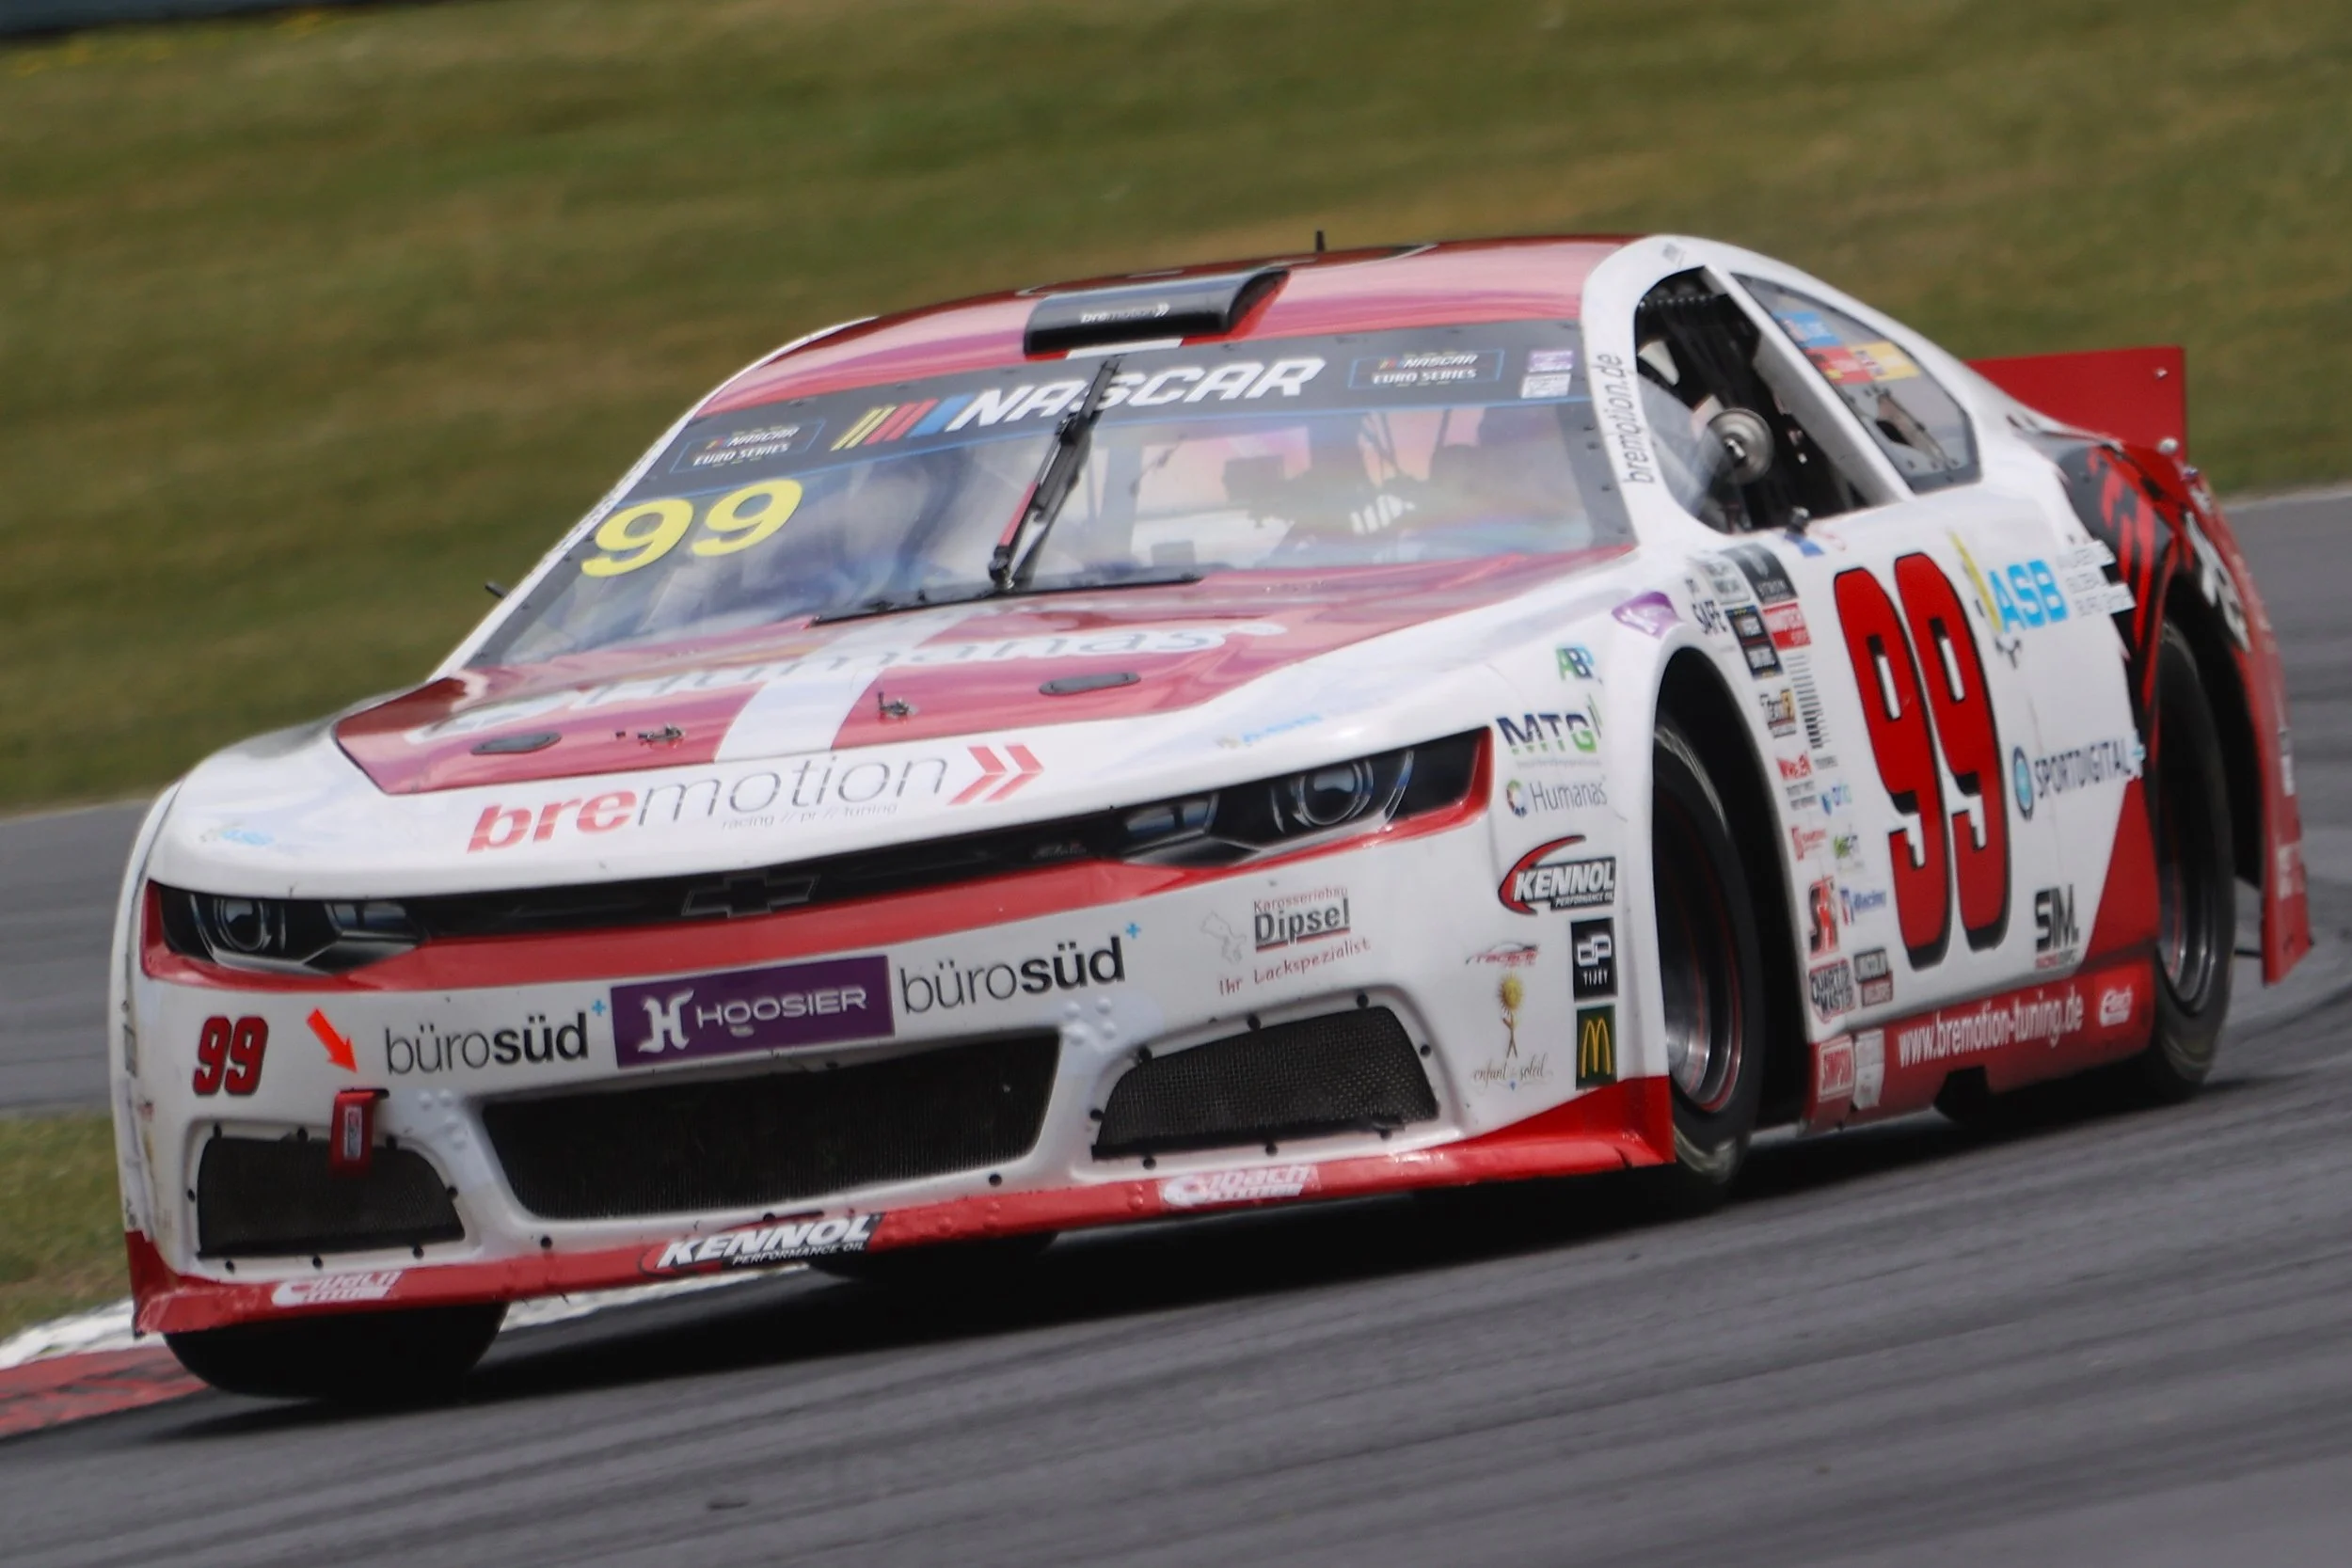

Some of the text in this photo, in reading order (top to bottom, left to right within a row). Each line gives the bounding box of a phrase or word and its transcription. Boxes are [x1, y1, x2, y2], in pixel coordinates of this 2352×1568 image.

[1373, 368, 1477, 385] EURO SERIES
[1403, 355, 1478, 369] NASCAR
[945, 357, 1327, 433] NASCAR
[1589, 354, 1655, 483] bremotion.de
[692, 441, 789, 467] EURO SERIES
[726, 426, 800, 448] NASCAR
[580, 479, 803, 578] 99
[1987, 558, 2068, 633] ASB
[1496, 713, 1597, 755] MTG
[1833, 551, 2011, 972] 99
[1529, 780, 1608, 813] Humanas
[2034, 738, 2132, 799] SPORTDIGITAL
[467, 753, 948, 854] bremotion
[722, 814, 774, 830] racing
[1513, 861, 1614, 902] KENNOL
[1254, 897, 1350, 944] Dipsel
[900, 936, 1127, 1015] bürosüd
[1219, 937, 1372, 995] Ihr Lackspezialist
[696, 986, 866, 1029] HOOSIER
[1899, 984, 2084, 1068] www.bremotion-tuning.de
[193, 1016, 269, 1097] 99
[386, 1011, 589, 1074] bürosüd
[657, 1214, 871, 1269] KENNOL
[731, 1240, 866, 1265] PERFORMANCE OIL
